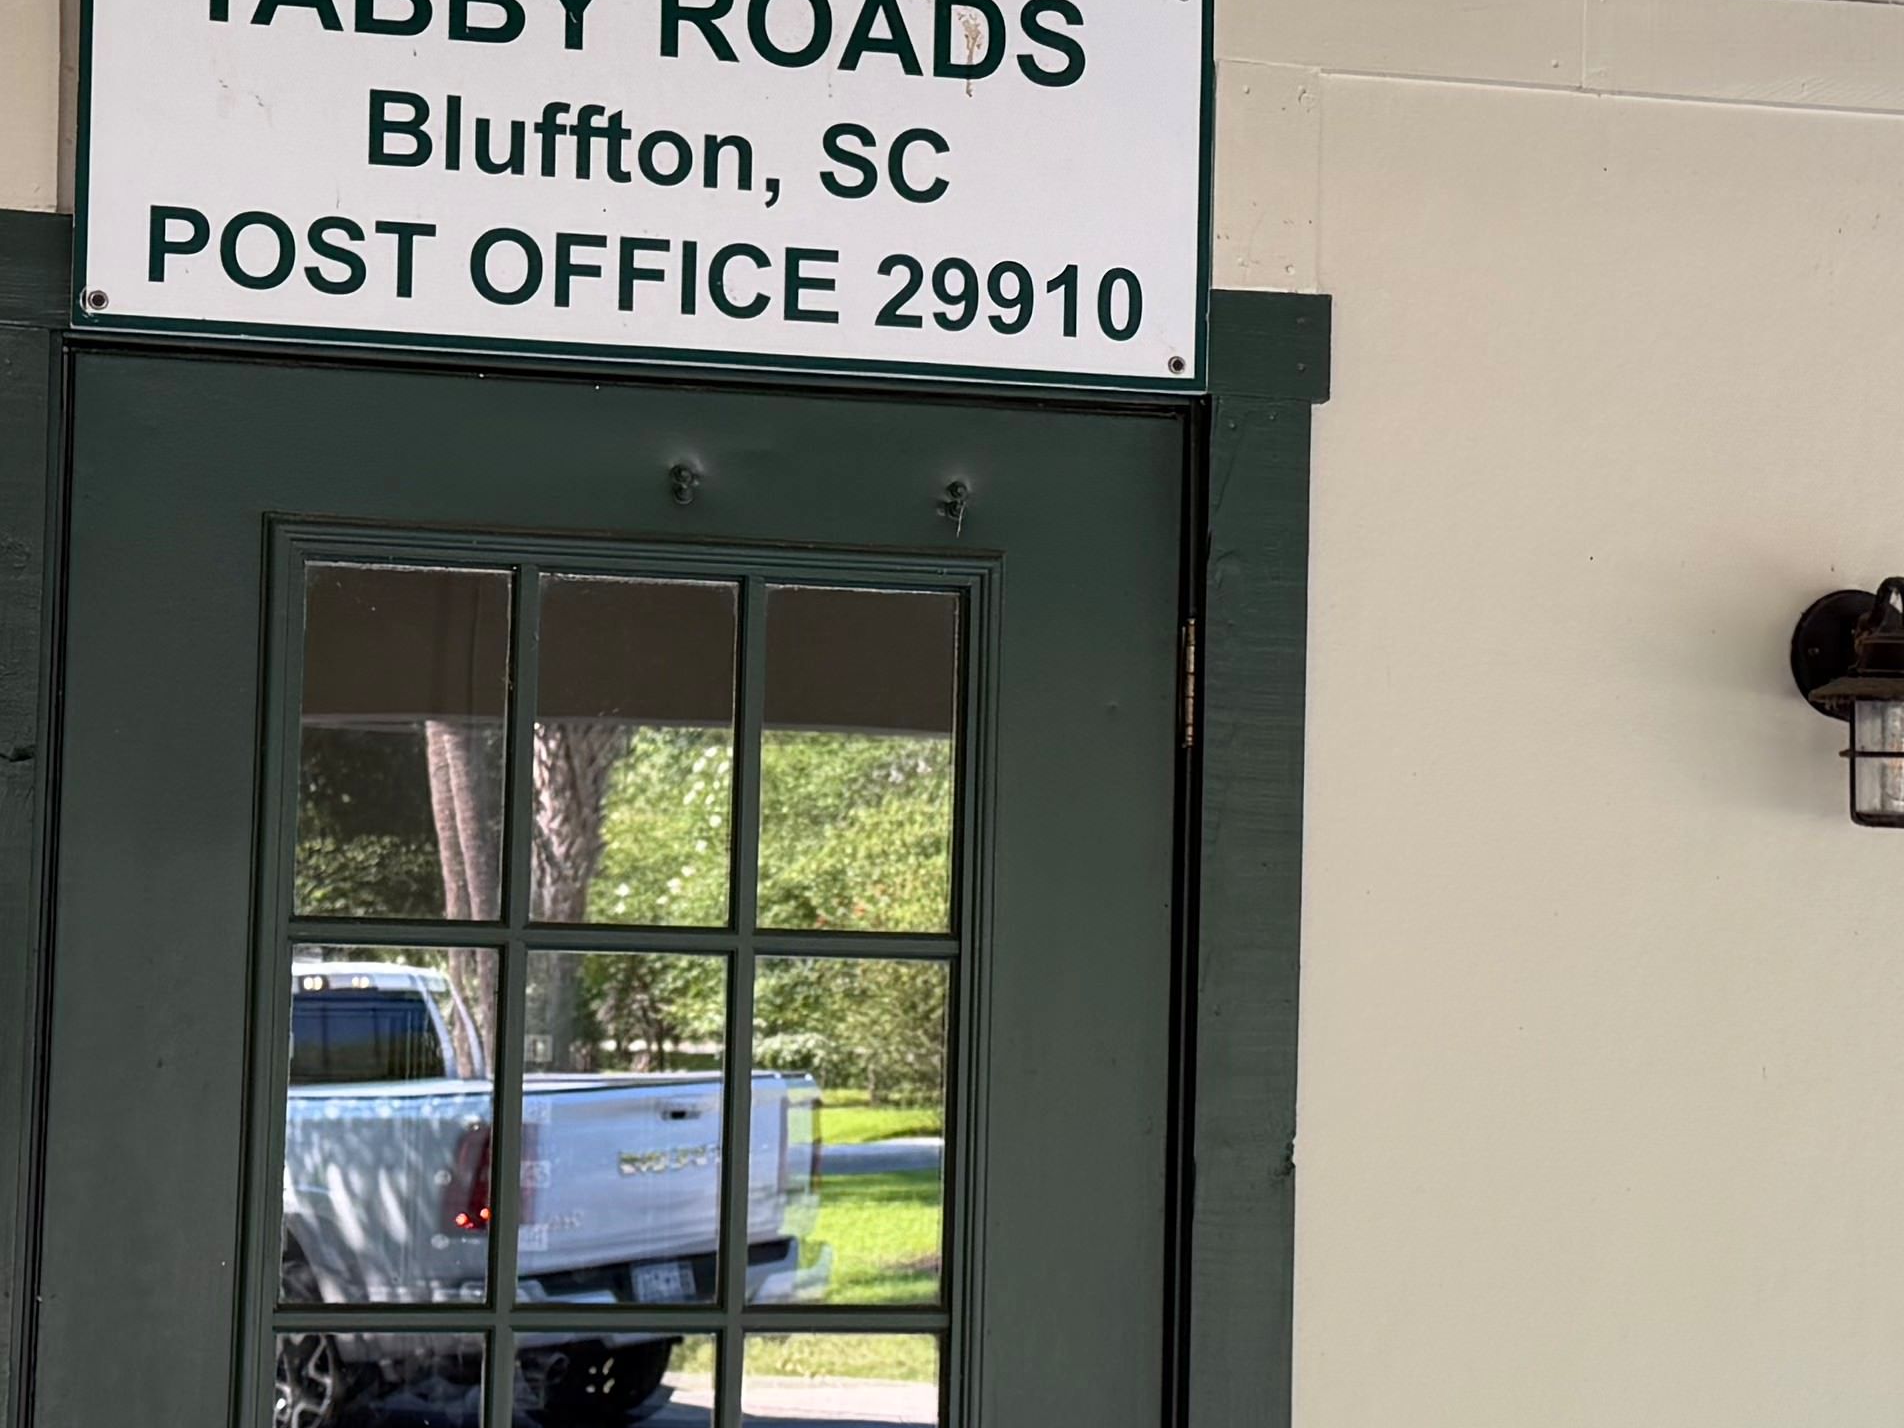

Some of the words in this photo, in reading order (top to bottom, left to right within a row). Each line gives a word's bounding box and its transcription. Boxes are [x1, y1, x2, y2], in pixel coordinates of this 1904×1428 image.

[368, 88, 780, 208] Bluffton,
[819, 122, 950, 204] SC
[148, 204, 437, 299] POST
[470, 227, 839, 324] OFFICE
[874, 253, 1143, 342] 29910
